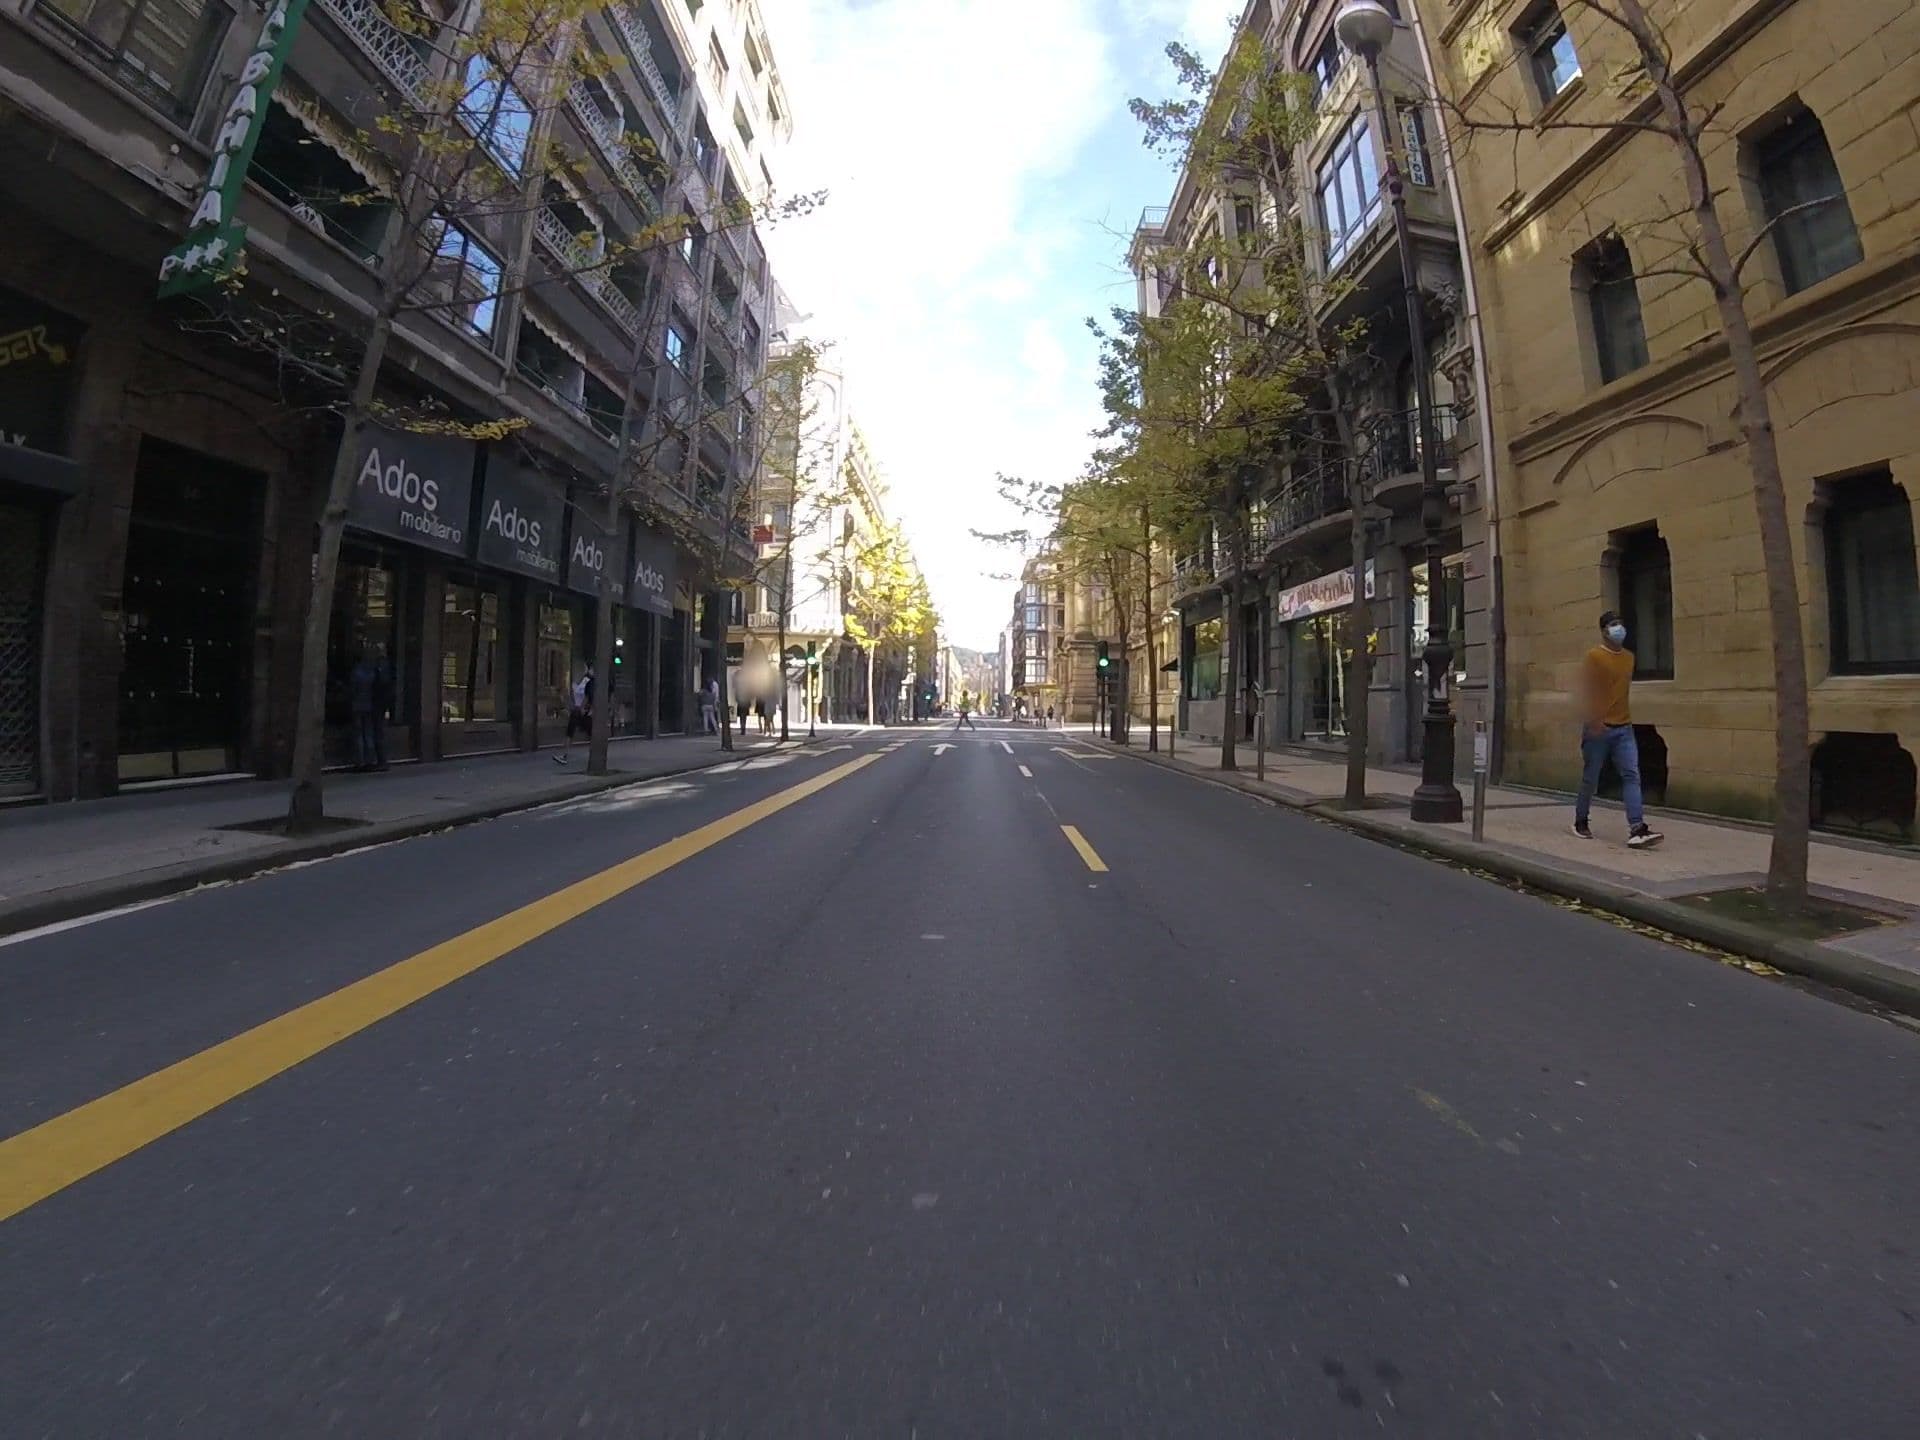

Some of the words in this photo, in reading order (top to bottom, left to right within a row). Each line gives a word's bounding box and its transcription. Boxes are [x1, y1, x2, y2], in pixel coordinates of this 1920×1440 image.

[189, 50, 275, 229] BAHIA
[357, 447, 440, 511] Ados
[486, 499, 541, 547] Ados
[572, 535, 604, 571] Ado
[634, 561, 665, 593] Ados
